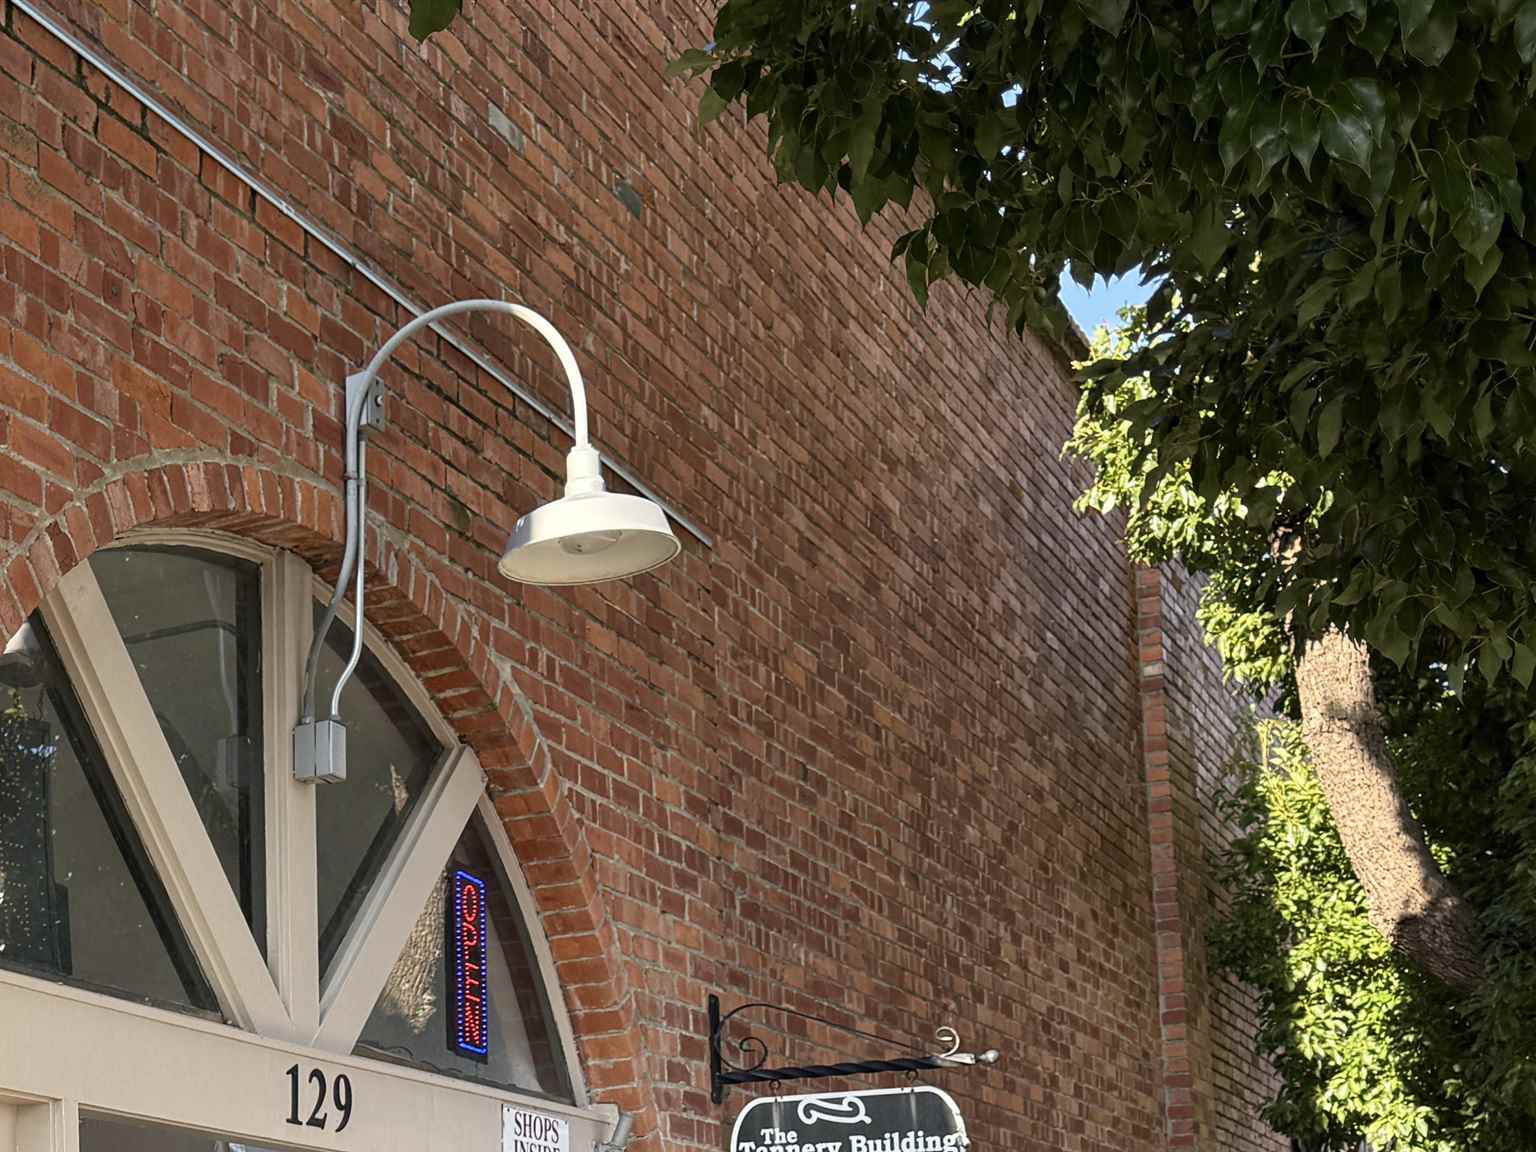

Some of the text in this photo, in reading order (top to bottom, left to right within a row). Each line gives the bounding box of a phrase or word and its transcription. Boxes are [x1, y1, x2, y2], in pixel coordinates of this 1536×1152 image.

[463, 884, 480, 1044] OPEN
[285, 1063, 353, 1133] 129
[514, 1111, 560, 1144] SHOPS
[761, 1128, 797, 1145] The
